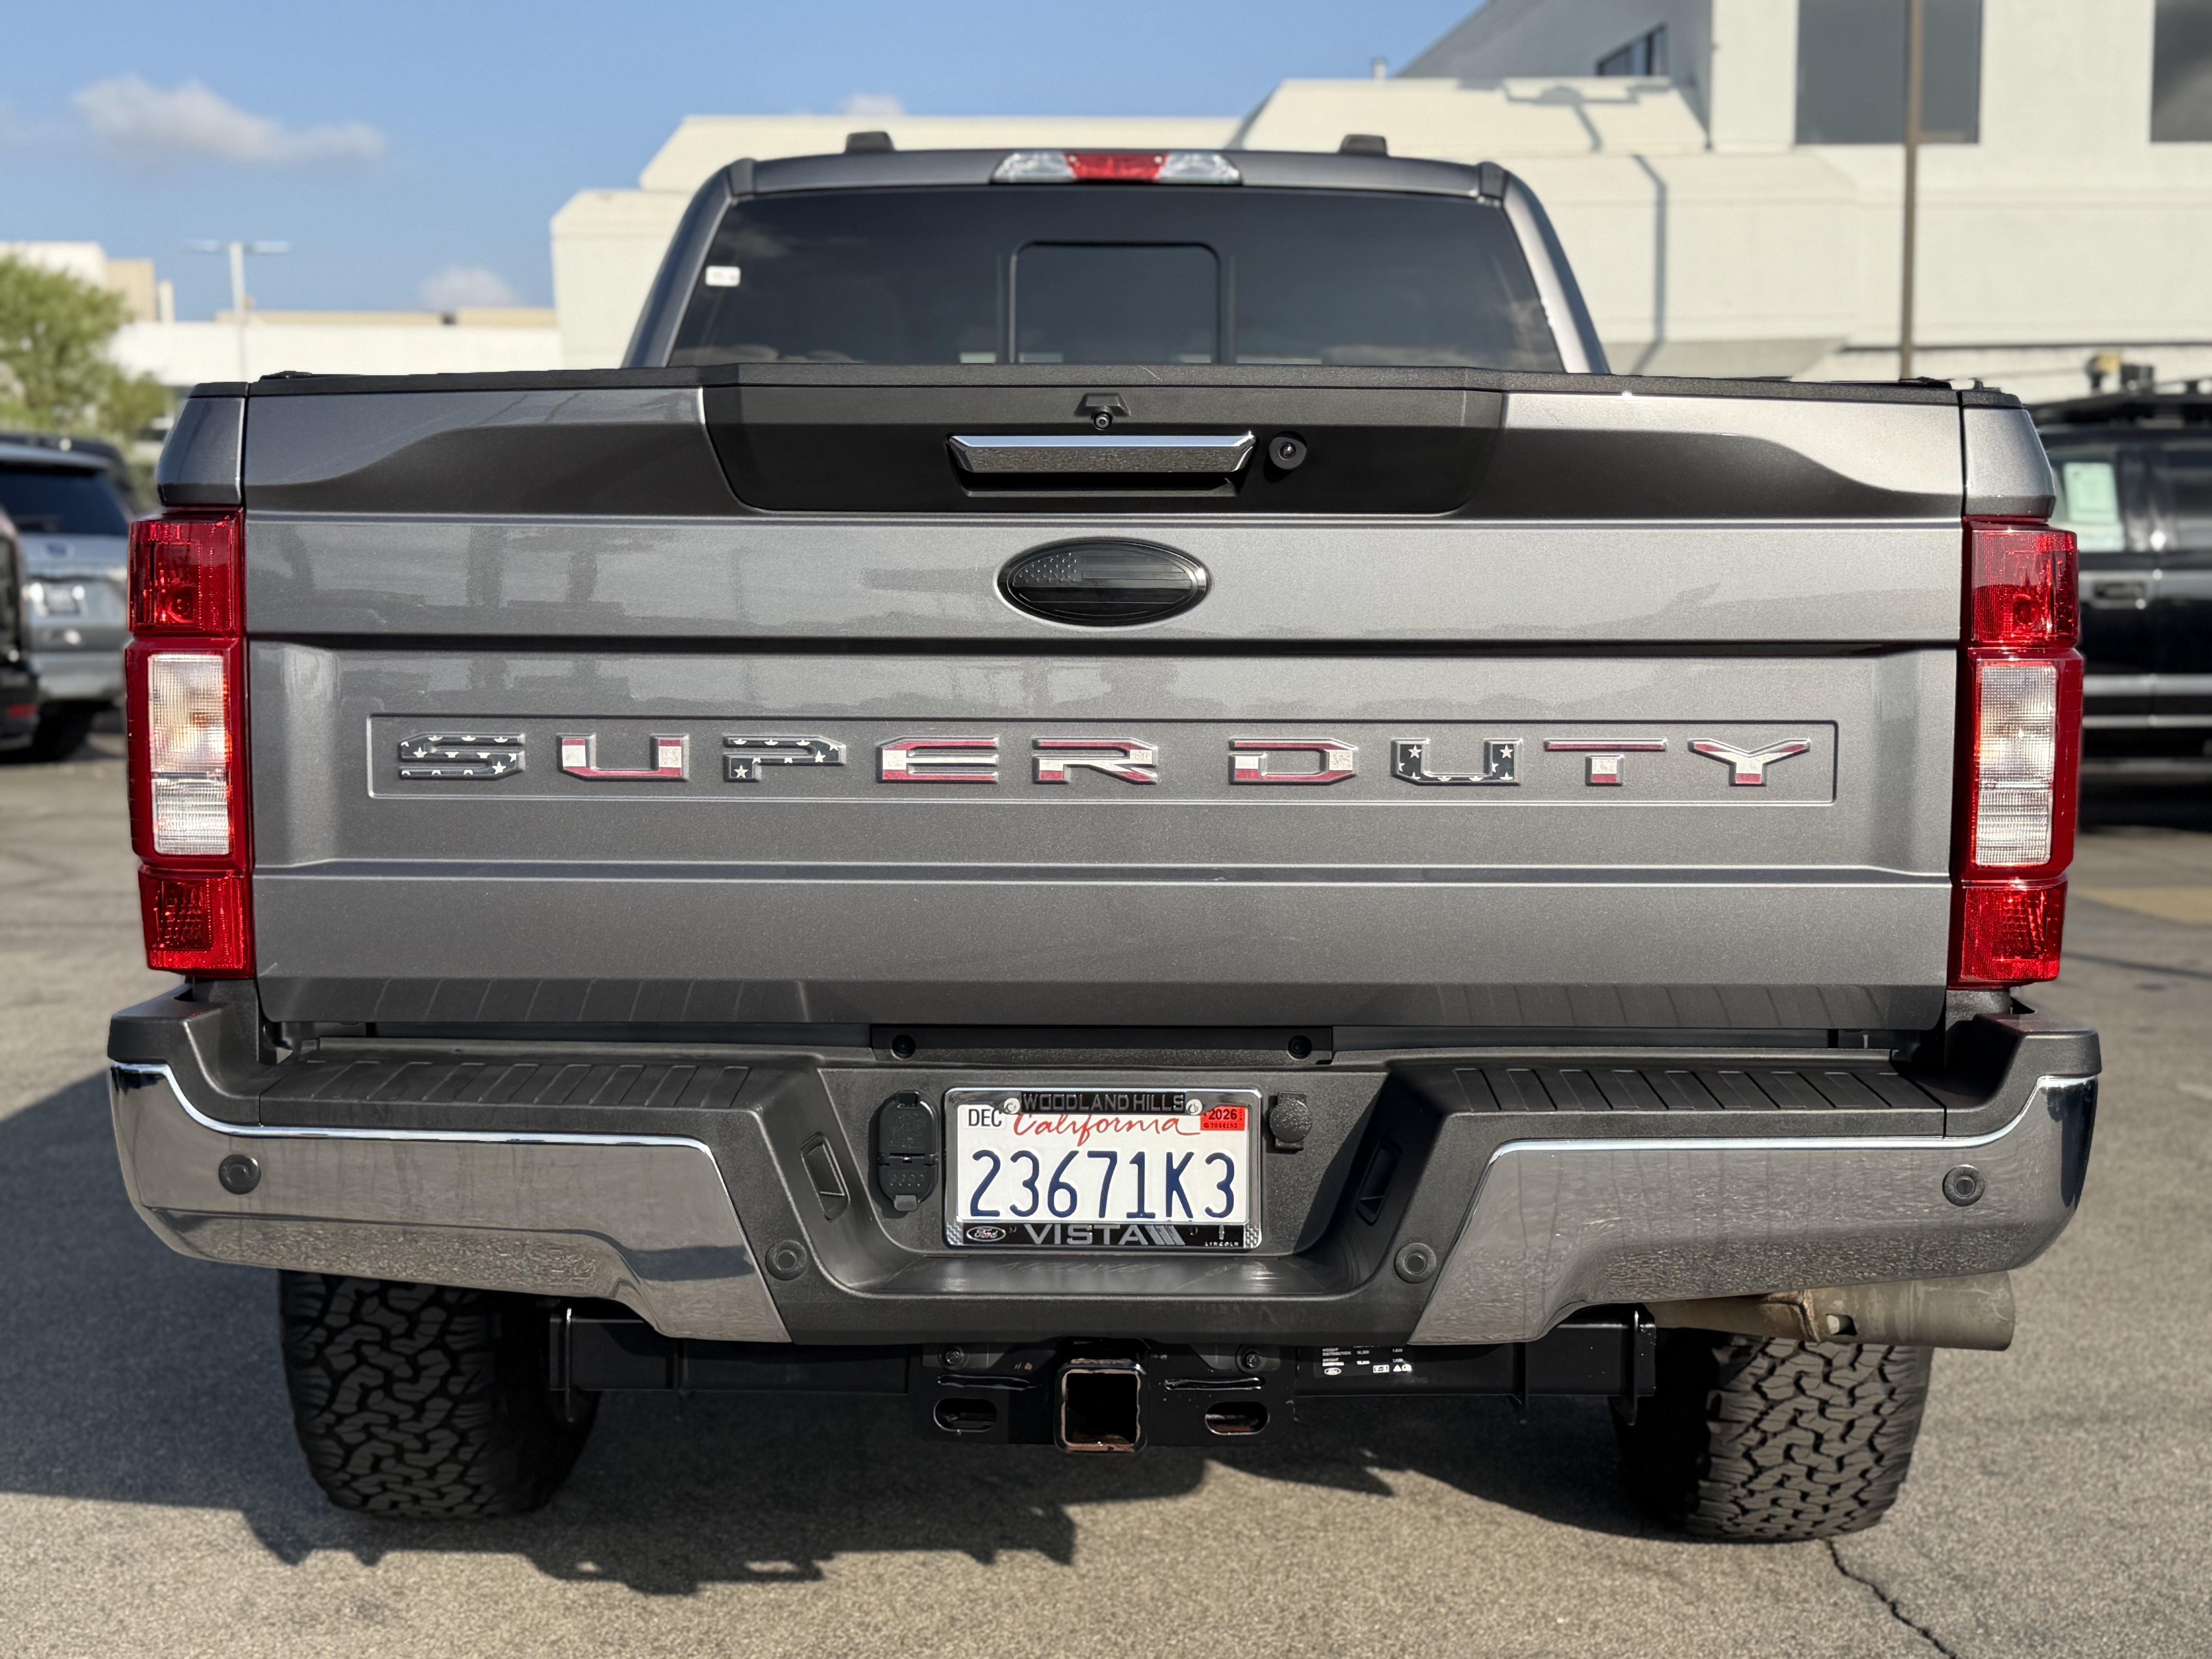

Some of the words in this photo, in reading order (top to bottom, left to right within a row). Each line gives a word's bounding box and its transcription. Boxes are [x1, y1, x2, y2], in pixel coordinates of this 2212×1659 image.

[397, 731, 1158, 784] SUPER
[1228, 738, 1811, 786] DUTY
[1023, 1094, 1130, 1111] WOODLAND
[1133, 1094, 1184, 1111] HILLS
[969, 1108, 1002, 1127] DEC
[1208, 1109, 1237, 1120] 2026
[1013, 1114, 1200, 1147] California
[970, 1149, 1235, 1219] 23671K3
[1024, 1223, 1149, 1245] VISTA
